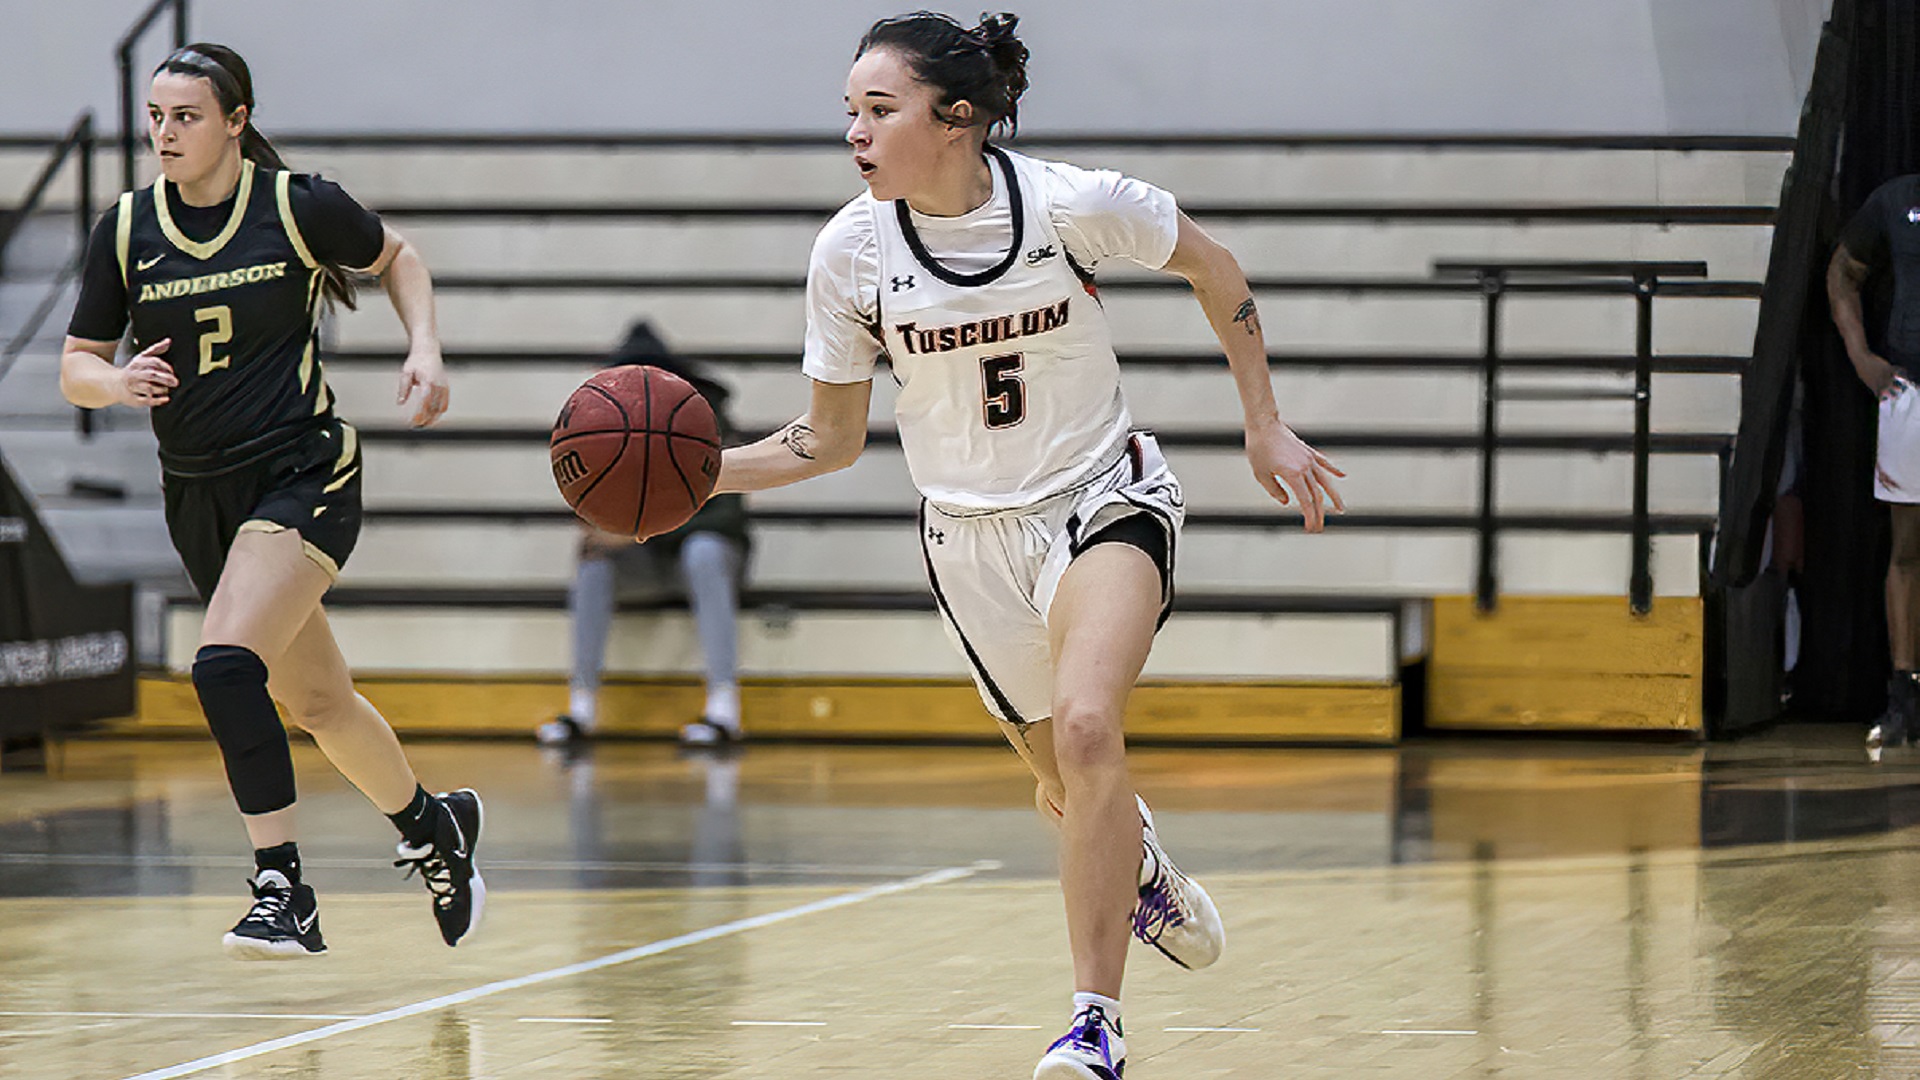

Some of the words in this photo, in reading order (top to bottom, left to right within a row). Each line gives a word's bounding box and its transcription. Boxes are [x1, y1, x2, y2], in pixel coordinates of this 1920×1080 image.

[138, 262, 287, 303] ANDERSON
[194, 305, 233, 375] 2
[895, 297, 1071, 354] TUSCULUM
[979, 351, 1027, 430] 5
